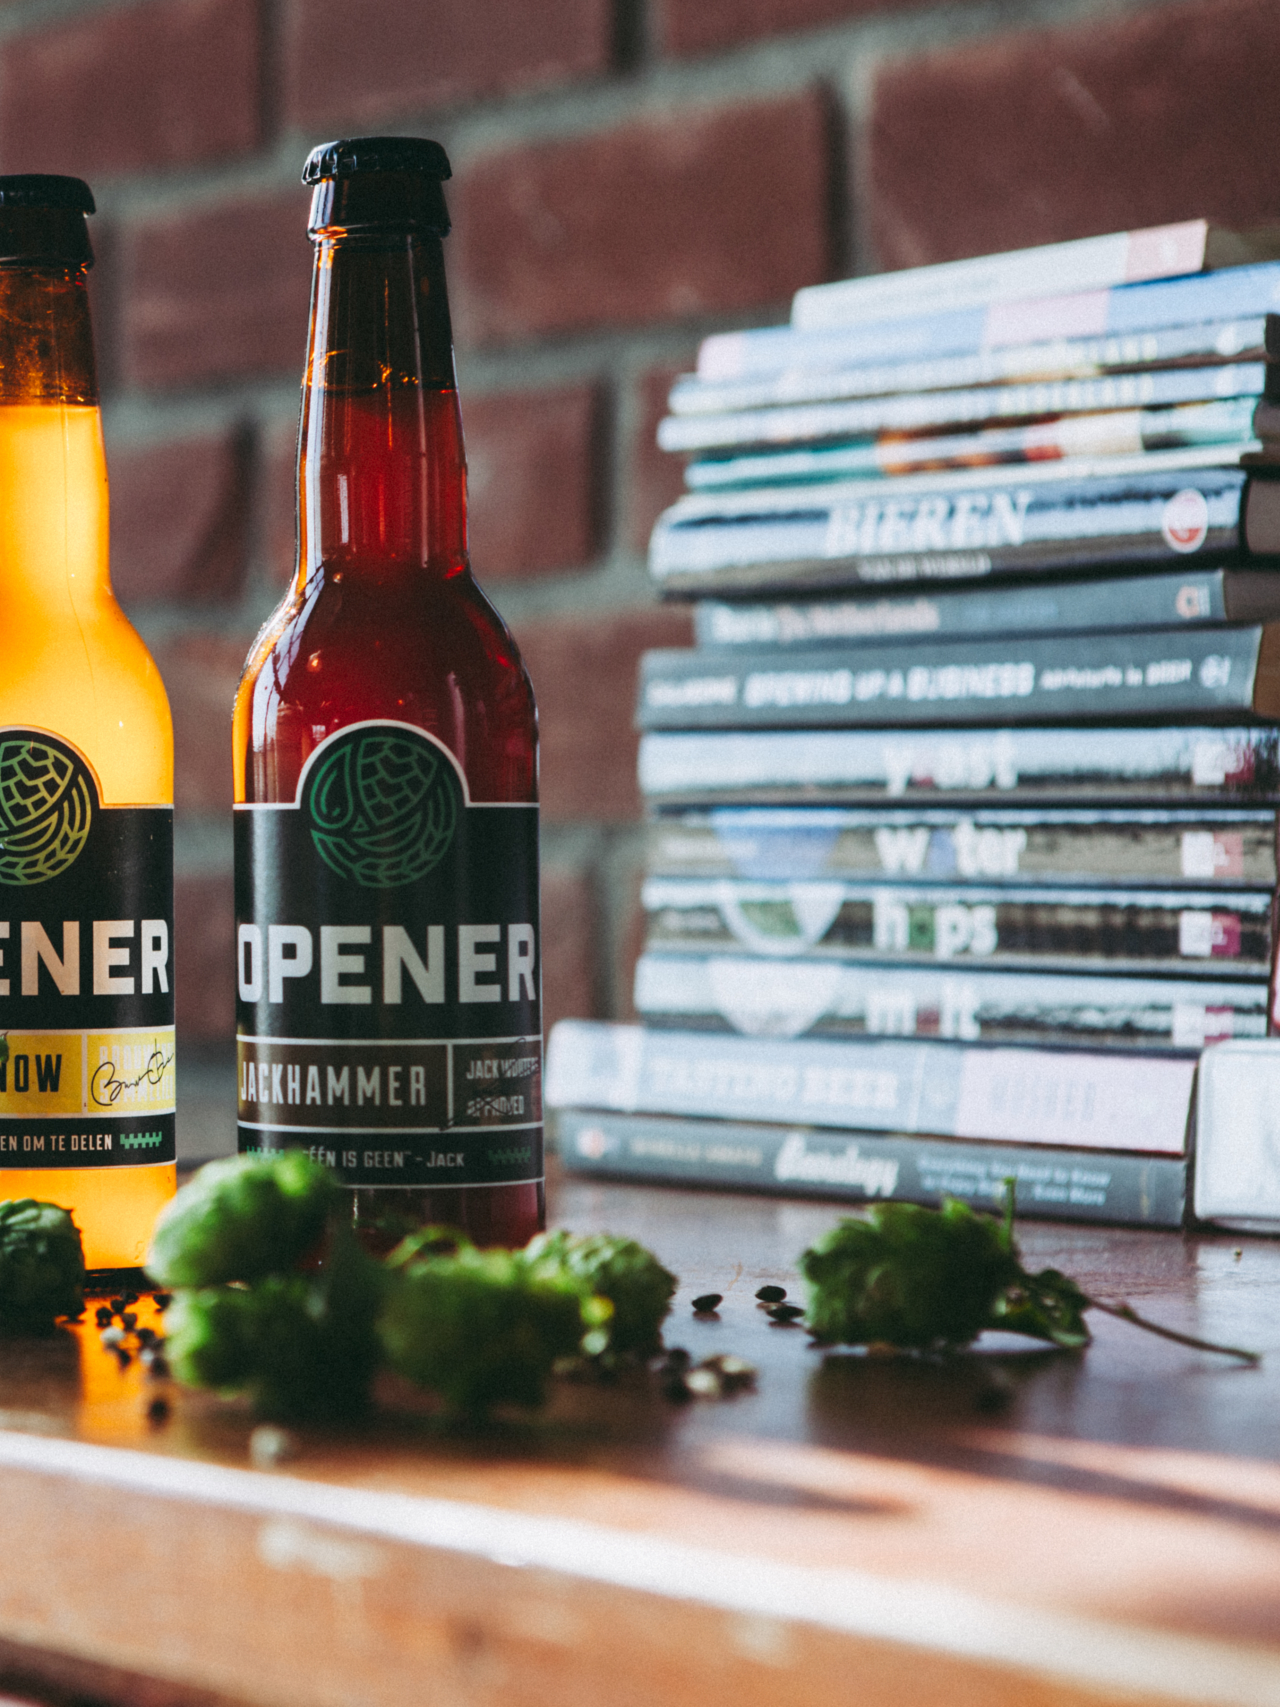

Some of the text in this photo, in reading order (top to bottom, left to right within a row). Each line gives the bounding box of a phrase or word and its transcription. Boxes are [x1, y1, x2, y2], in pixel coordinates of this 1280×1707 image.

[825, 490, 1036, 559] BIEREN
[238, 923, 537, 1004] OPENER
[240, 1061, 426, 1106] JACKHAMMER
[466, 1059, 499, 1080] JACK
[23, 1135, 44, 1151] OM
[50, 1135, 66, 1151] TE
[71, 1134, 112, 1151] DELEN
[342, 1151, 357, 1168] IS
